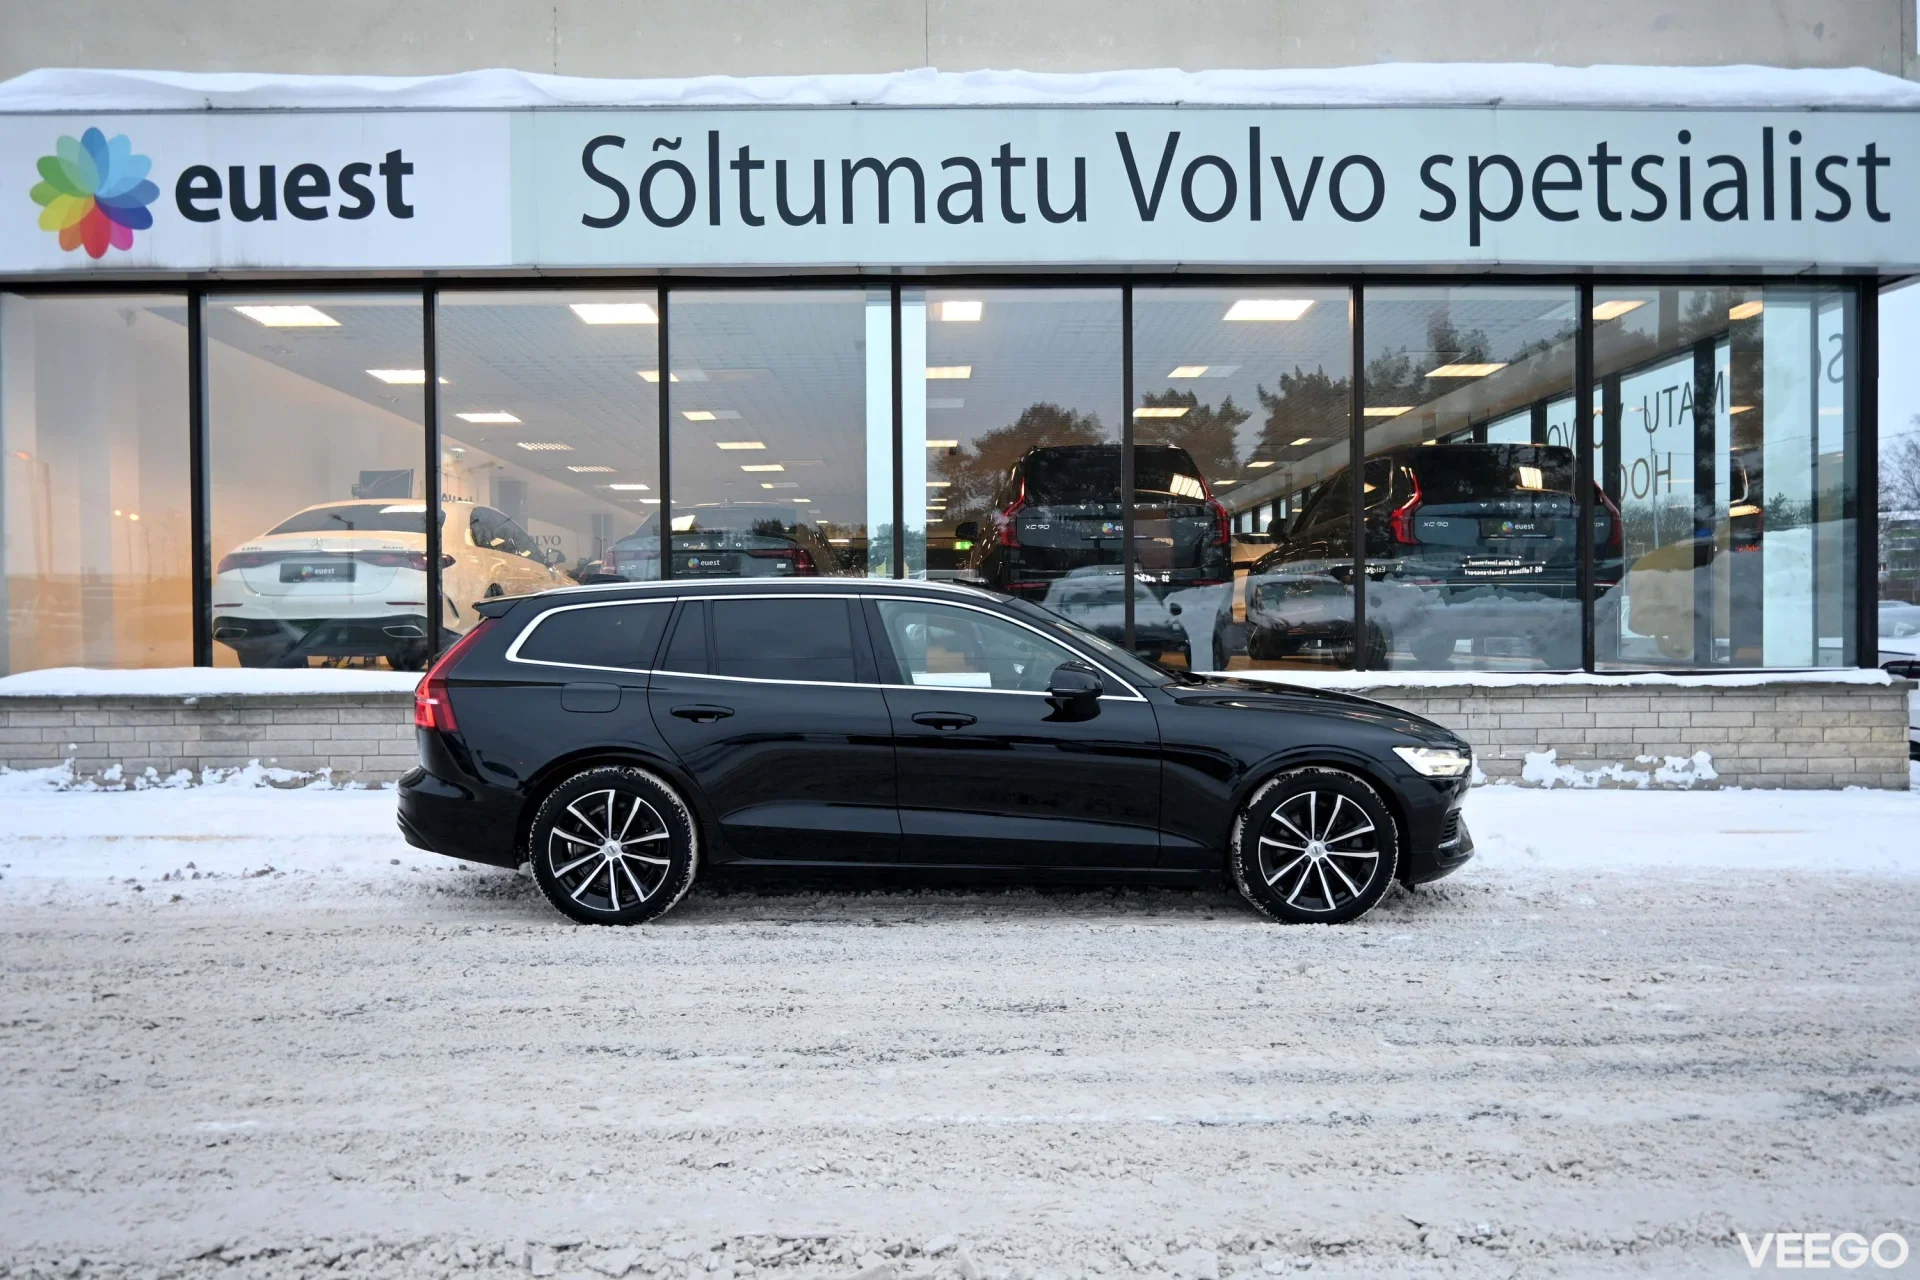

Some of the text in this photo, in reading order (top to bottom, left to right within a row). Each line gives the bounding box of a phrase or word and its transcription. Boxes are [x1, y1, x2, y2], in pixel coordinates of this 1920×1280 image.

[176, 149, 413, 222] euest
[582, 127, 1890, 246] Sõltumatu Volvo spetsialist
[1514, 522, 1535, 530] euest
[700, 559, 721, 567] euest
[314, 567, 336, 575] euest
